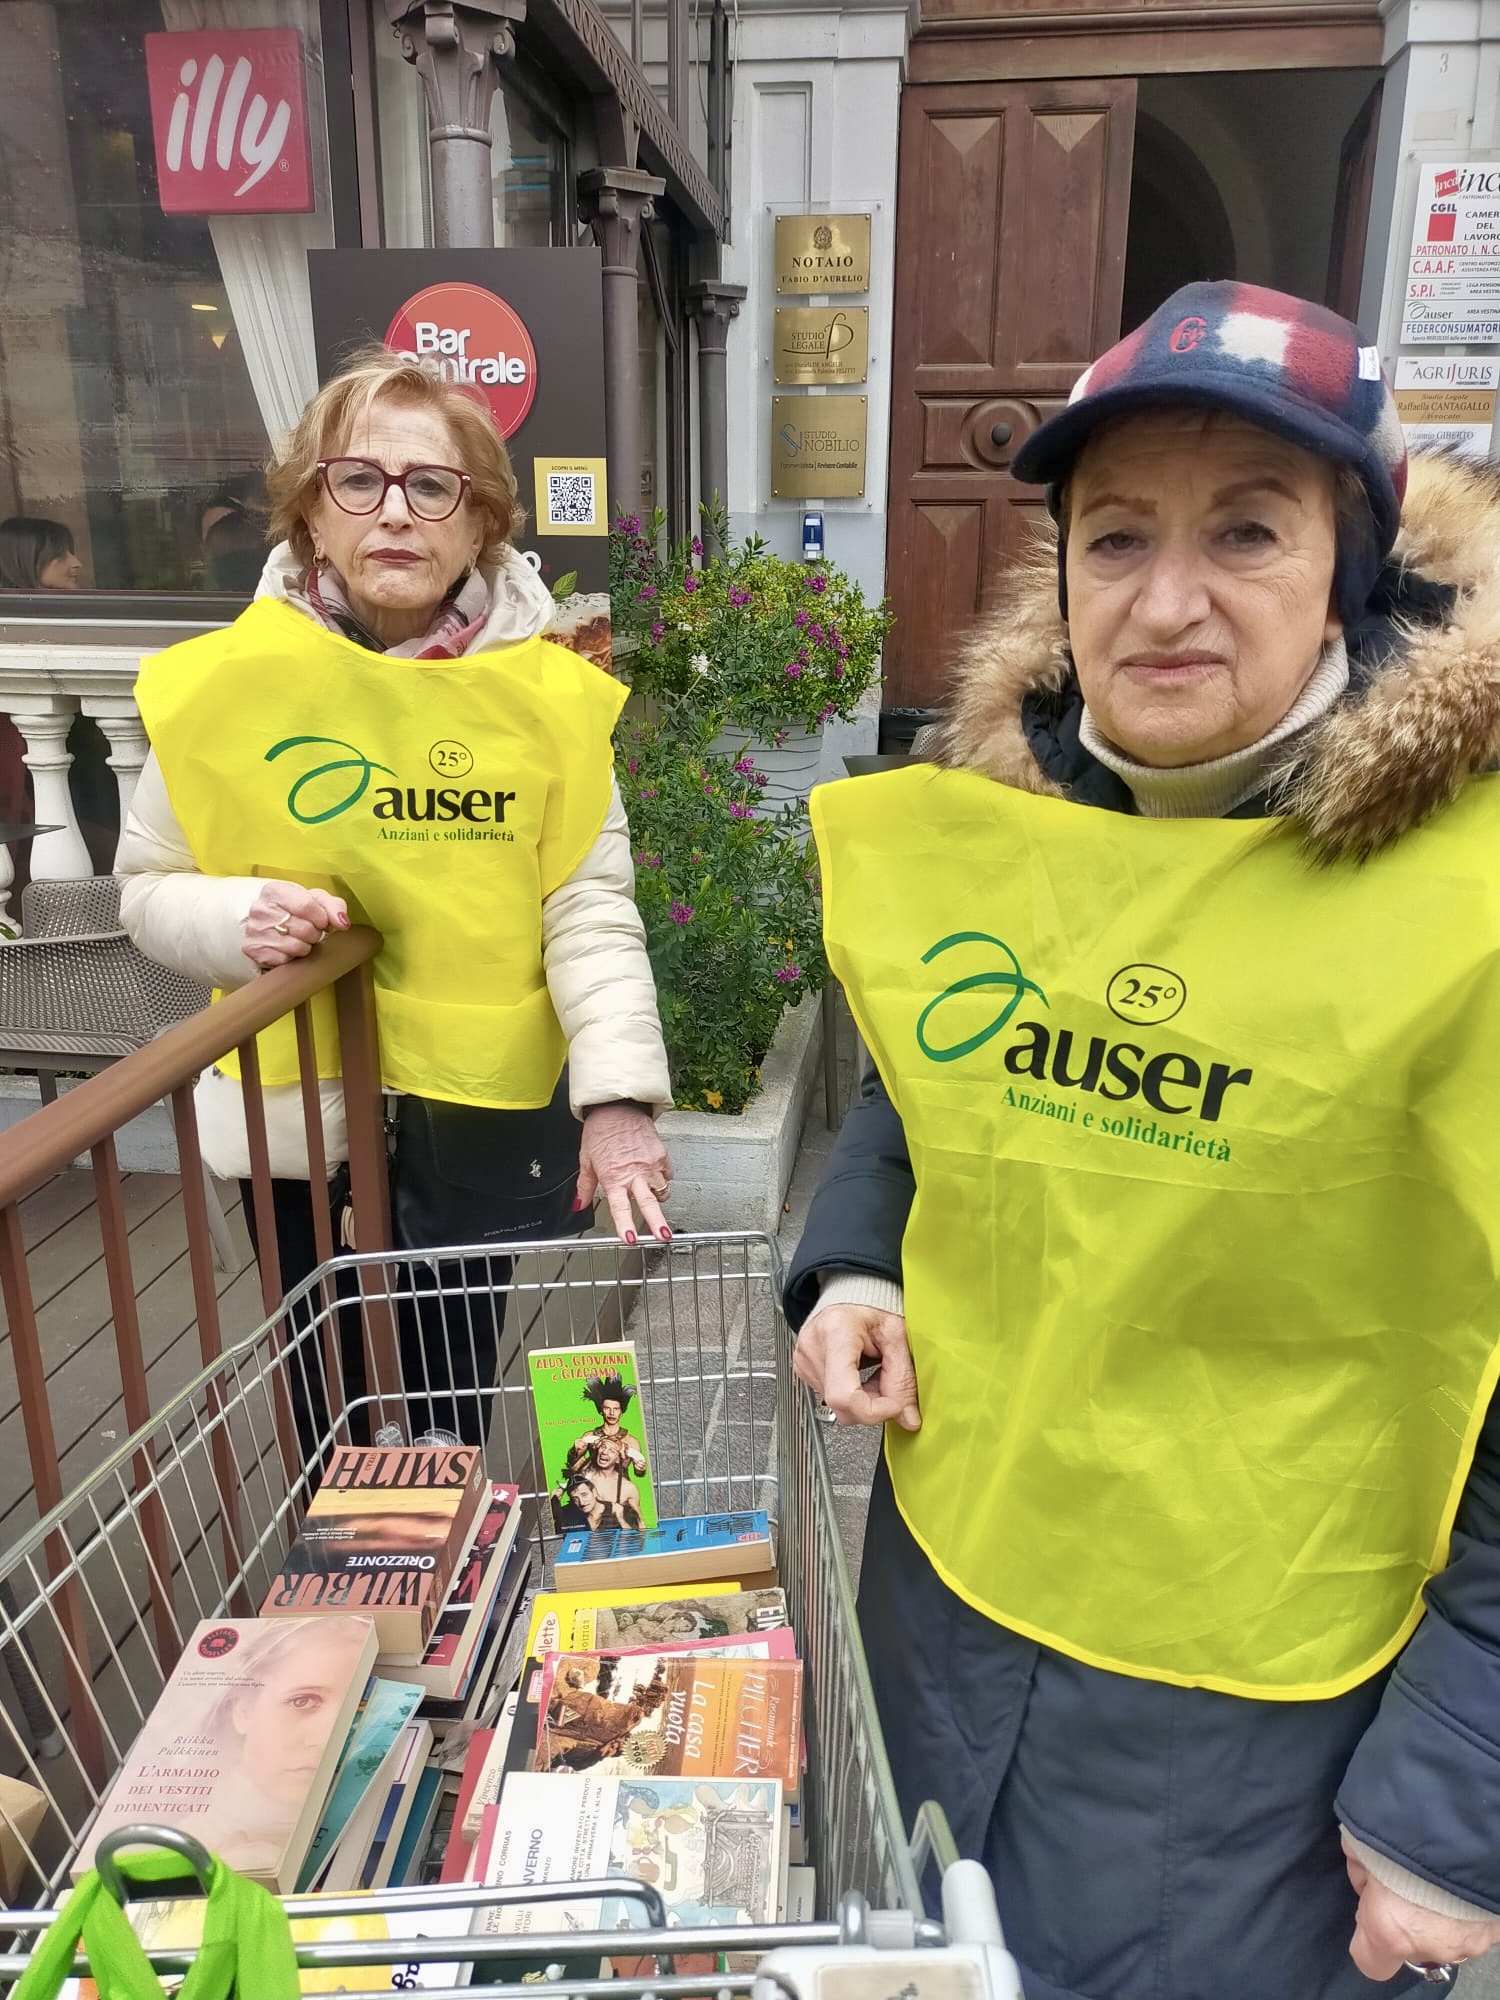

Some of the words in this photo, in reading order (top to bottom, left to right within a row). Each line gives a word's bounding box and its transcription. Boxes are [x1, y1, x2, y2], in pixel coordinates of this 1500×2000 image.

[166, 53, 292, 197] illy
[1458, 168, 1500, 193] inc
[1430, 203, 1458, 213] CGIL
[1476, 222, 1495, 230] DEL
[1416, 244, 1469, 255] PATRONATO
[792, 255, 853, 268] NOTAIO
[1412, 260, 1456, 274] C.A.A.F.
[782, 275, 809, 283] FABIO
[812, 275, 863, 283] D'AURELIO
[1410, 284, 1436, 298] S.P.I.
[1423, 311, 1453, 320] auser
[415, 321, 471, 355] Bar
[791, 331, 825, 341] STUDIO
[791, 341, 825, 349] LEGALE
[1430, 401, 1490, 411] CANTAGALLO
[803, 431, 837, 439] STUDIO
[804, 439, 860, 452] NOBILIO
[373, 786, 516, 823] auser
[377, 826, 430, 842] Anziani
[433, 829, 440, 842] e
[443, 828, 515, 843] solidarietà
[1003, 1020, 1254, 1122] auser
[1001, 1085, 1077, 1124] Anziani
[1082, 1111, 1094, 1128] e
[1101, 1115, 1233, 1162] solidarietà
[572, 1354, 629, 1367] GIOVANNI
[561, 1366, 617, 1379] GIACOMO
[327, 1451, 474, 1489] SMITH
[345, 1554, 437, 1570] ORIZZONTE
[274, 1571, 422, 1607] WILBUR
[540, 1617, 556, 1656] llette
[691, 1680, 716, 1707] La
[665, 1690, 687, 1745] vuota
[733, 1671, 768, 1774] PILCHER
[766, 1695, 780, 1748] Rosamunde
[174, 1735, 215, 1745] Riikka
[685, 1712, 705, 1759] casa
[158, 1746, 220, 1757] Pulkkinen
[128, 1785, 154, 1795] DEI
[158, 1785, 214, 1796] VESTITI
[113, 1803, 211, 1813] DIMENTICATI
[499, 1829, 512, 1867] CORRIAS
